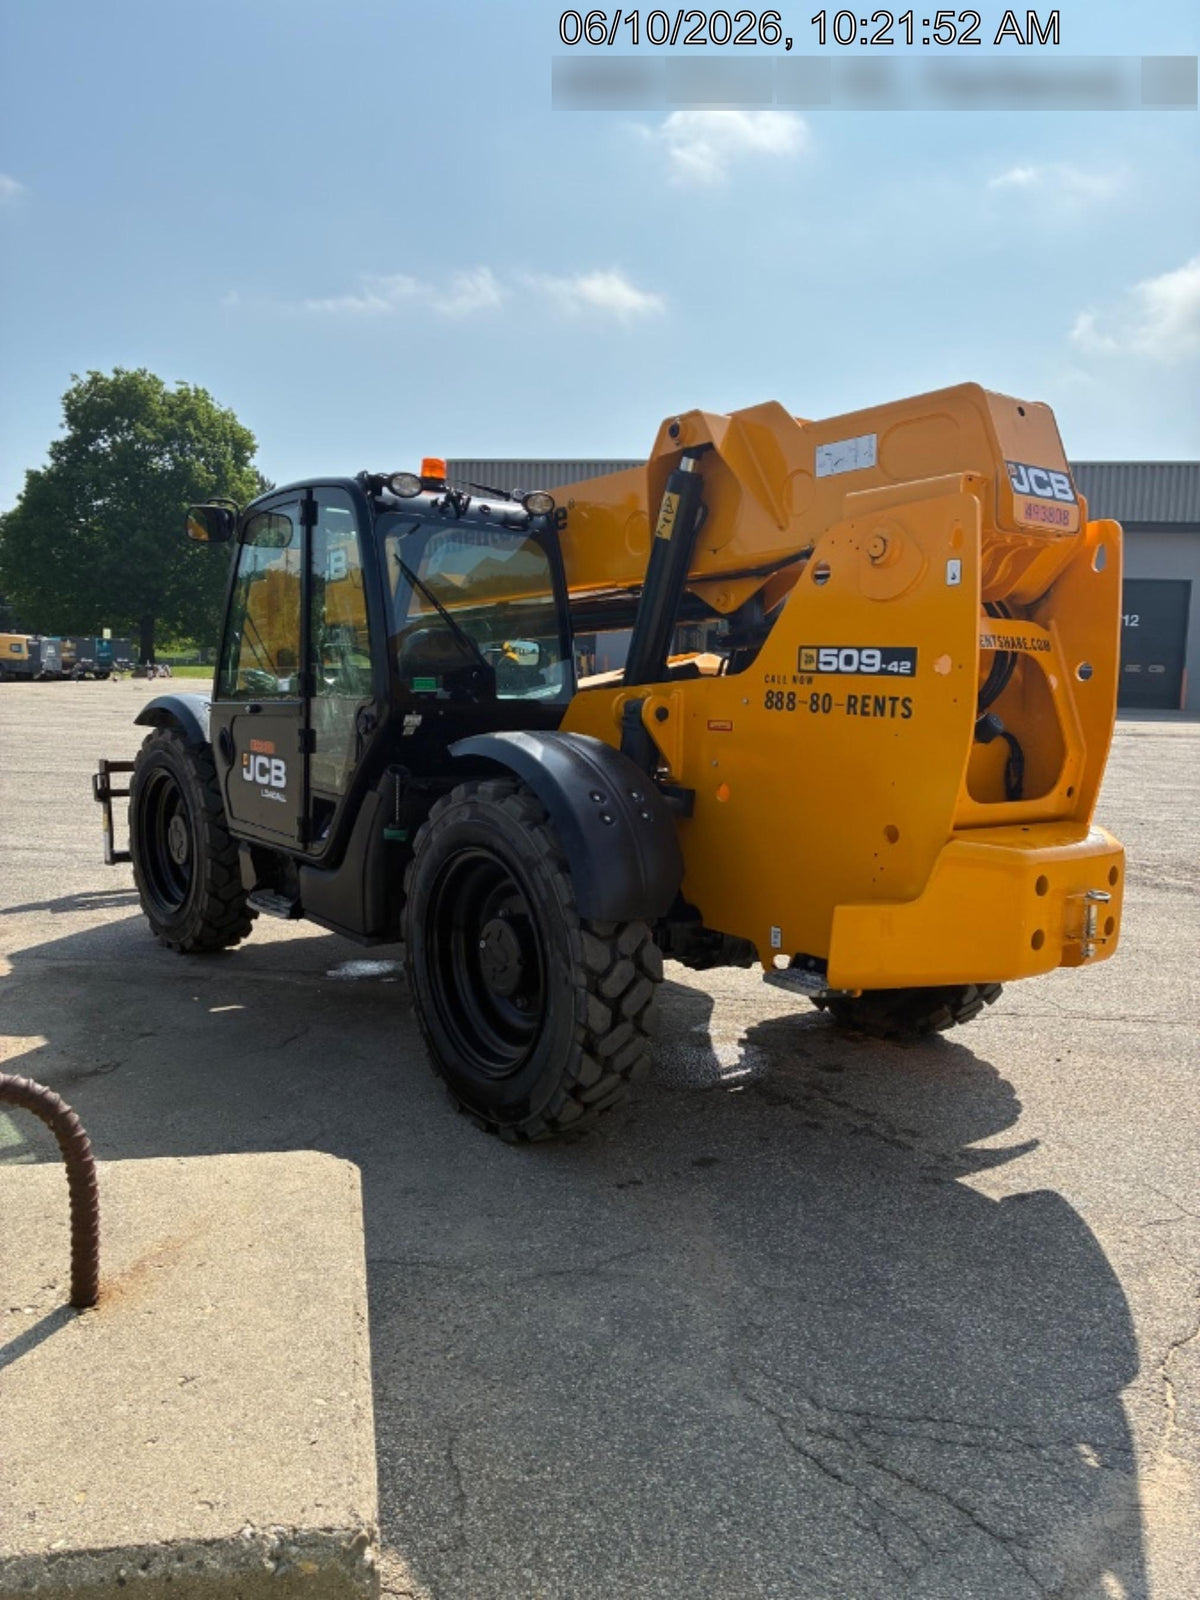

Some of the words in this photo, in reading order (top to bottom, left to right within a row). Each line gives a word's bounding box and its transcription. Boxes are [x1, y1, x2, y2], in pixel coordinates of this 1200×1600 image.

[1010, 464, 1075, 502] JCB
[1122, 613, 1140, 628] 12
[817, 647, 912, 674] 509-42
[764, 674, 788, 685] CALL
[792, 674, 814, 686] NOW
[763, 689, 914, 720] 888-80-RENTS
[242, 753, 287, 789] JCB
